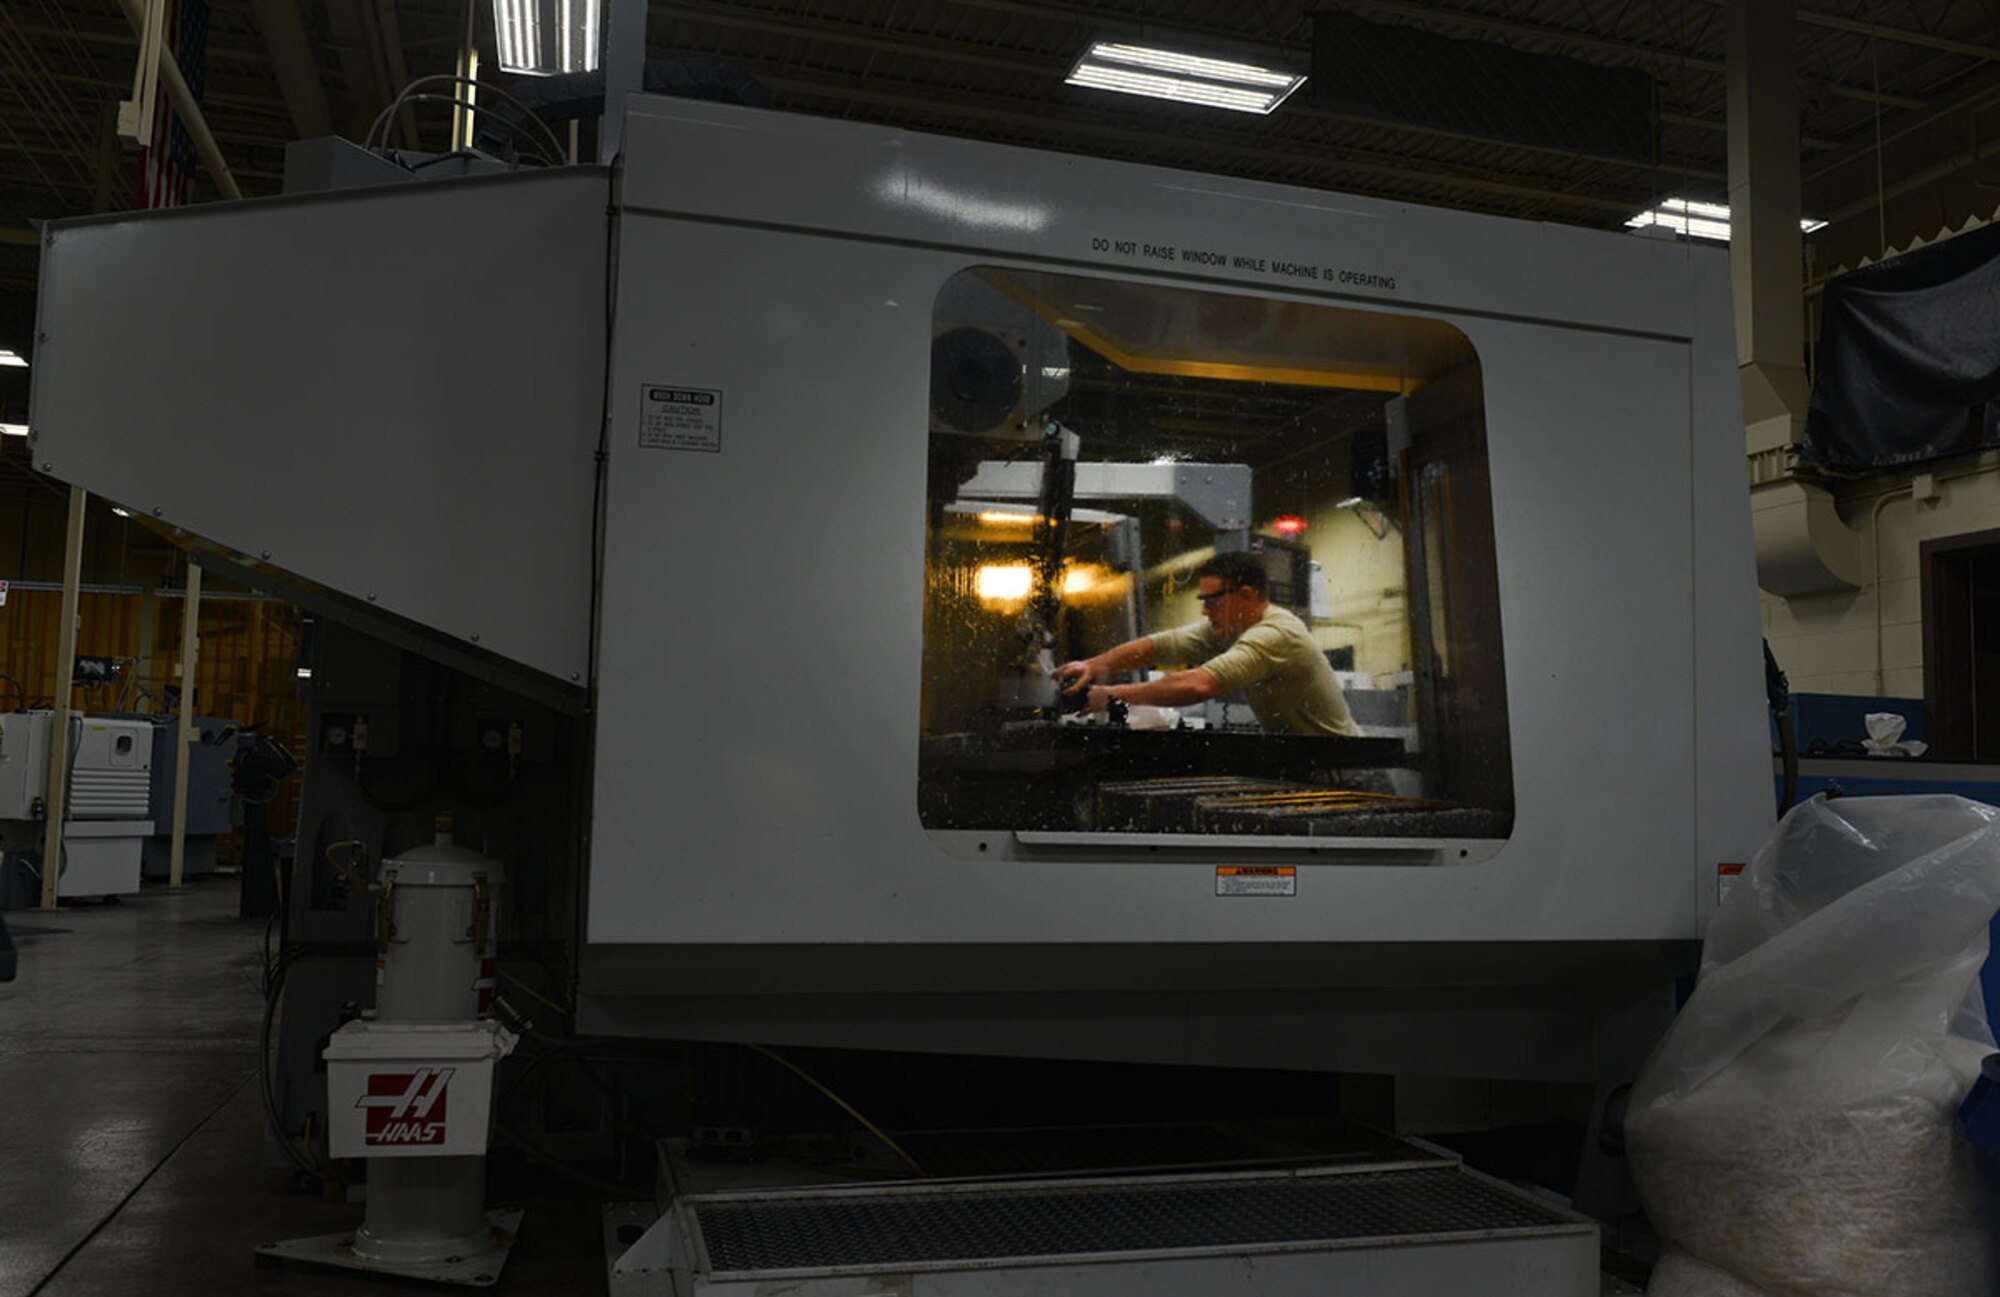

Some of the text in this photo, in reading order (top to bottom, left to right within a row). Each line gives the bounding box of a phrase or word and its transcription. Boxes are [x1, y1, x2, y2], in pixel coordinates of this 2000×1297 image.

[1092, 238, 1396, 290] DO NOT RAISE WINDOW WHILE MACHINE IS OPERATING
[663, 404, 701, 416] CAUTION
[1241, 867, 1278, 876] WARNING
[366, 1122, 446, 1142] HAAS
